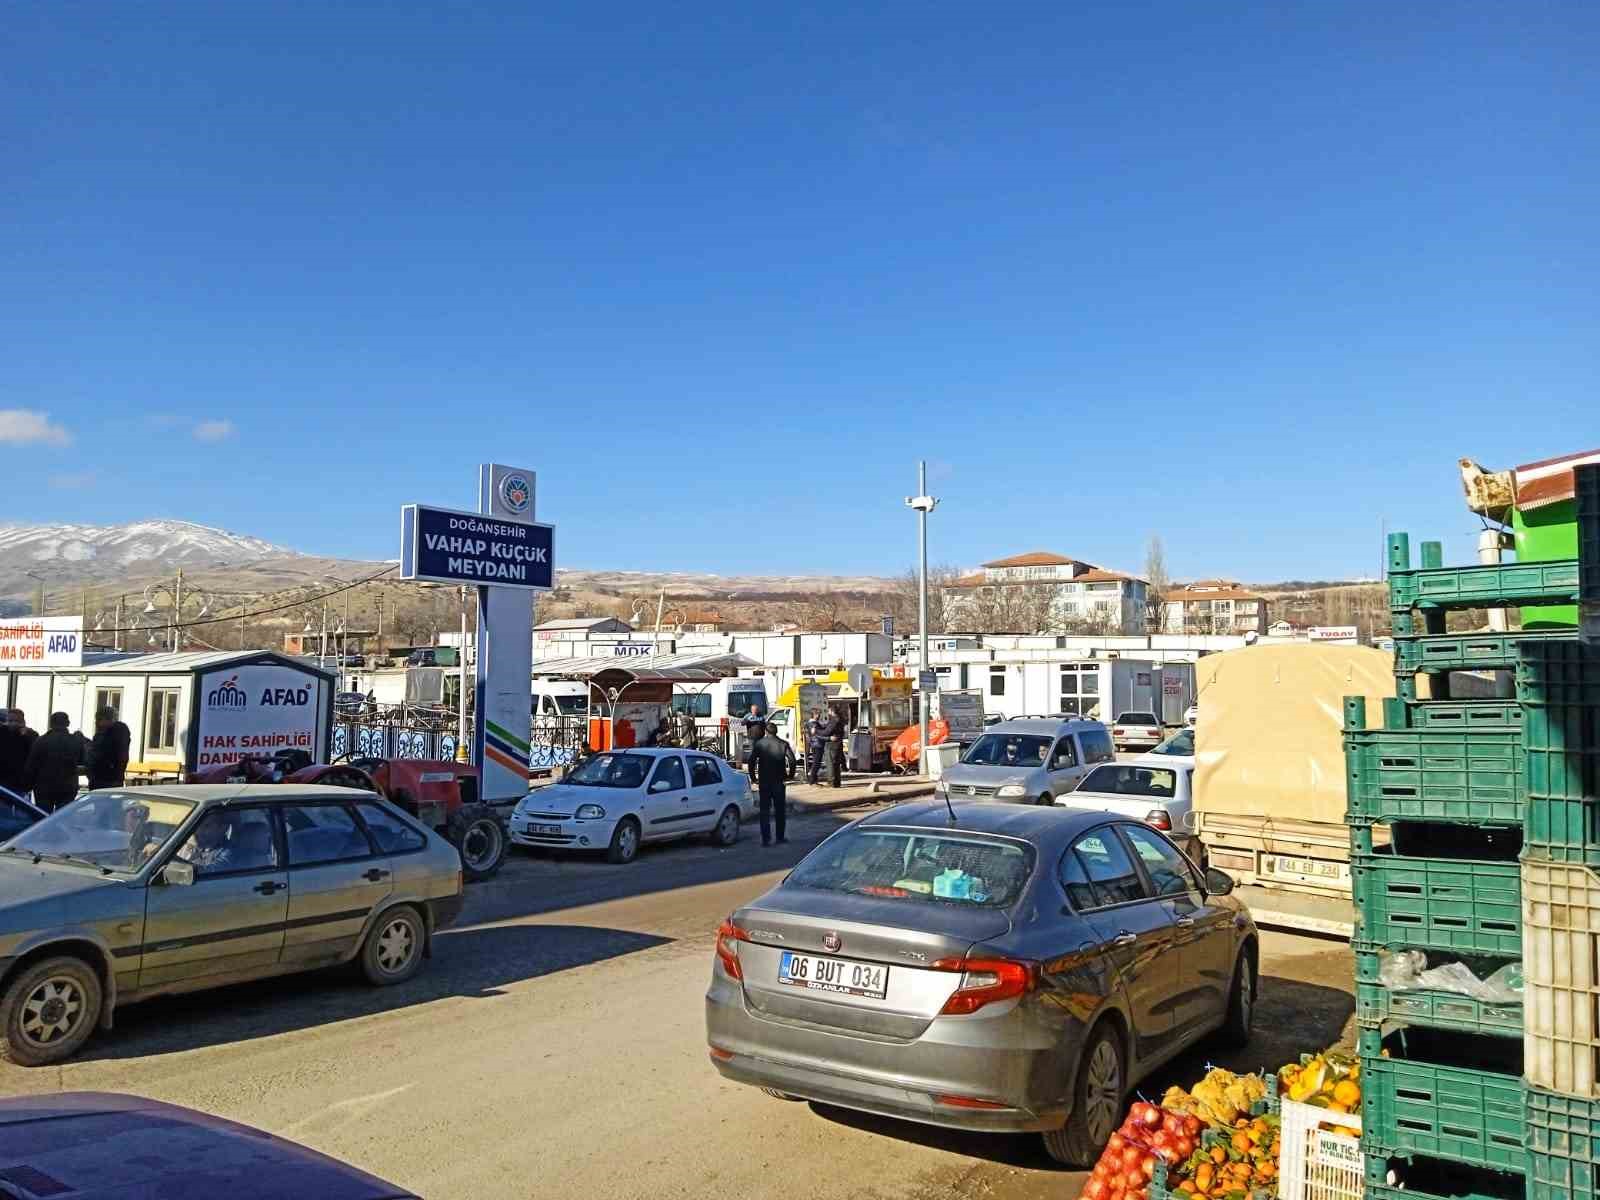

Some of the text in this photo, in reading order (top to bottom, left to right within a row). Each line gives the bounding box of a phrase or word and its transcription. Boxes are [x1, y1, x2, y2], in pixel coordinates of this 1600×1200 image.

[449, 518, 527, 538] DOĞANŞEHİR
[424, 533, 547, 563] VAHAP KÜÇÜK
[448, 557, 527, 580] MEYDANI
[0, 642, 44, 660] MA OFİSİ
[48, 635, 76, 653] AFAD
[614, 646, 651, 656] MDK
[259, 688, 309, 706] AFAD
[203, 731, 312, 748] HAK SAHİPLİĞİ
[790, 957, 881, 989] 06 BUT 034
[1320, 1139, 1337, 1152] NUR
